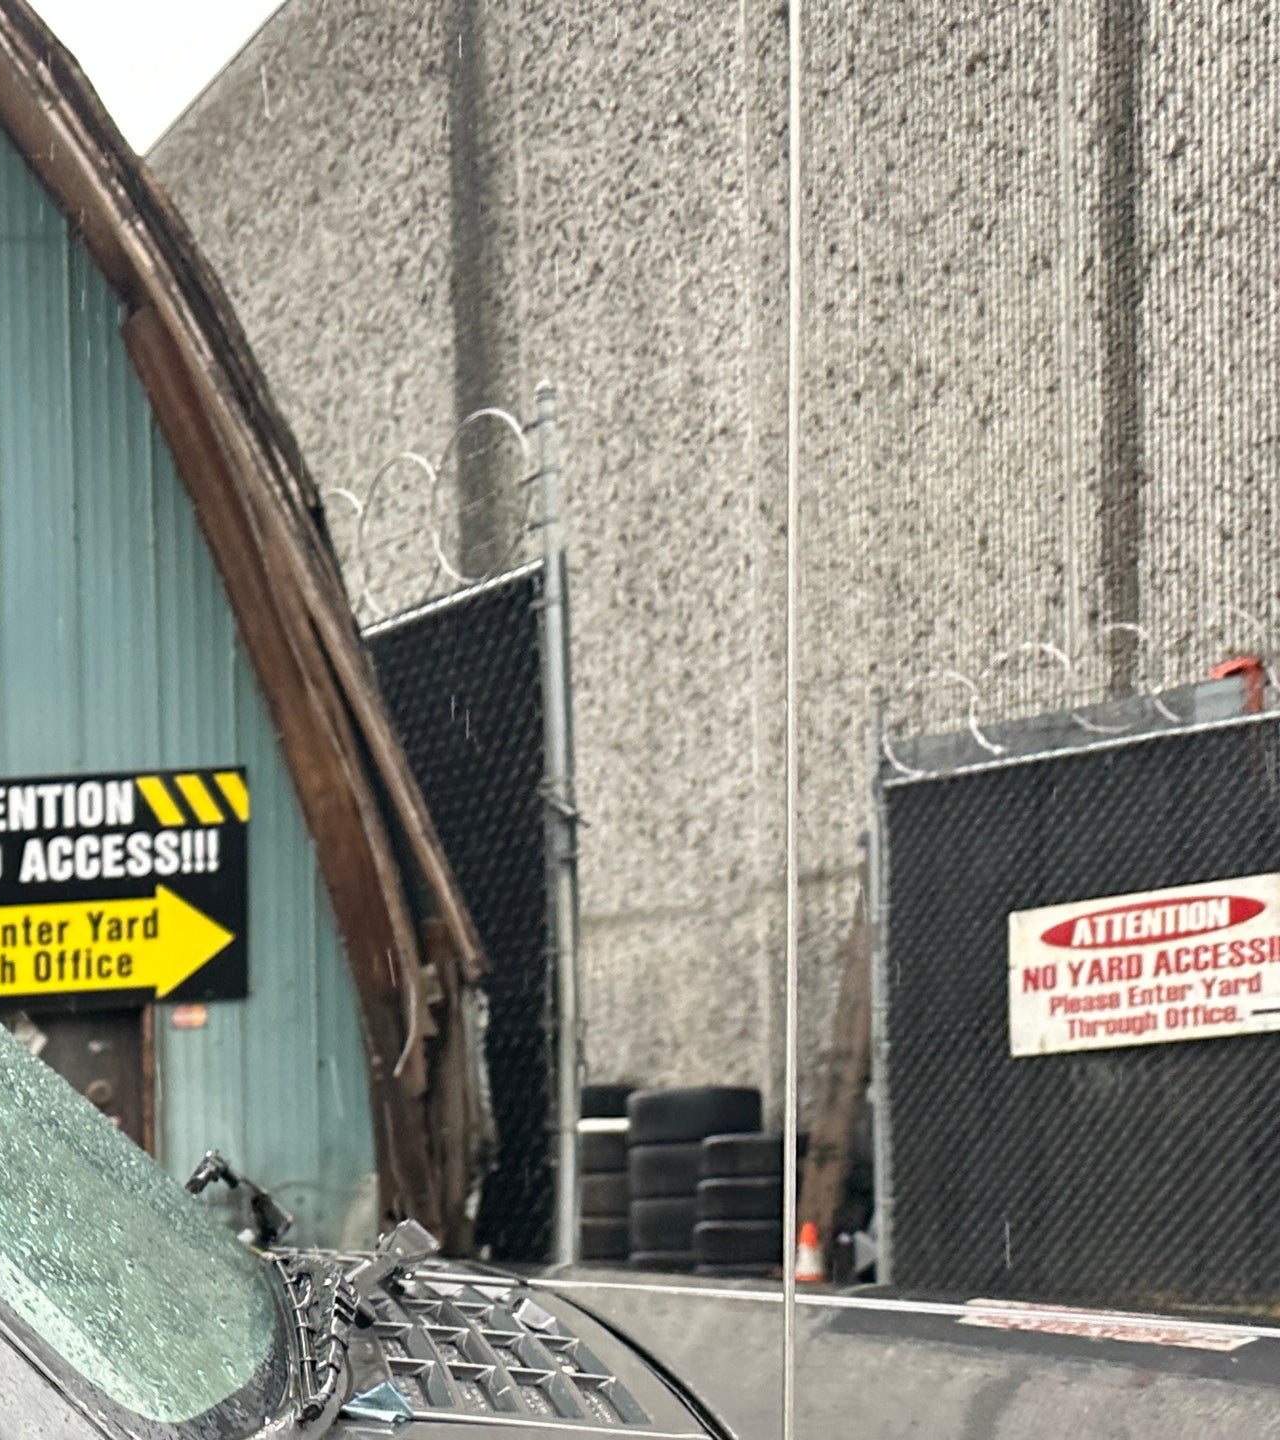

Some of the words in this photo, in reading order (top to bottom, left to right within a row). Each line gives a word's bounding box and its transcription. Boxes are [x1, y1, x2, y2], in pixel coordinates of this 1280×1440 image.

[19, 828, 220, 884] ACCESS!!!
[87, 907, 159, 942] Yard
[1072, 899, 1229, 946] ATTENTION
[34, 948, 133, 982] Office
[1023, 964, 1057, 993] NO
[1068, 954, 1142, 987] YARD
[1049, 991, 1121, 1016] Please
[1127, 983, 1194, 1007] Enter
[1201, 972, 1262, 999] Yard
[1068, 1012, 1158, 1039] Through
